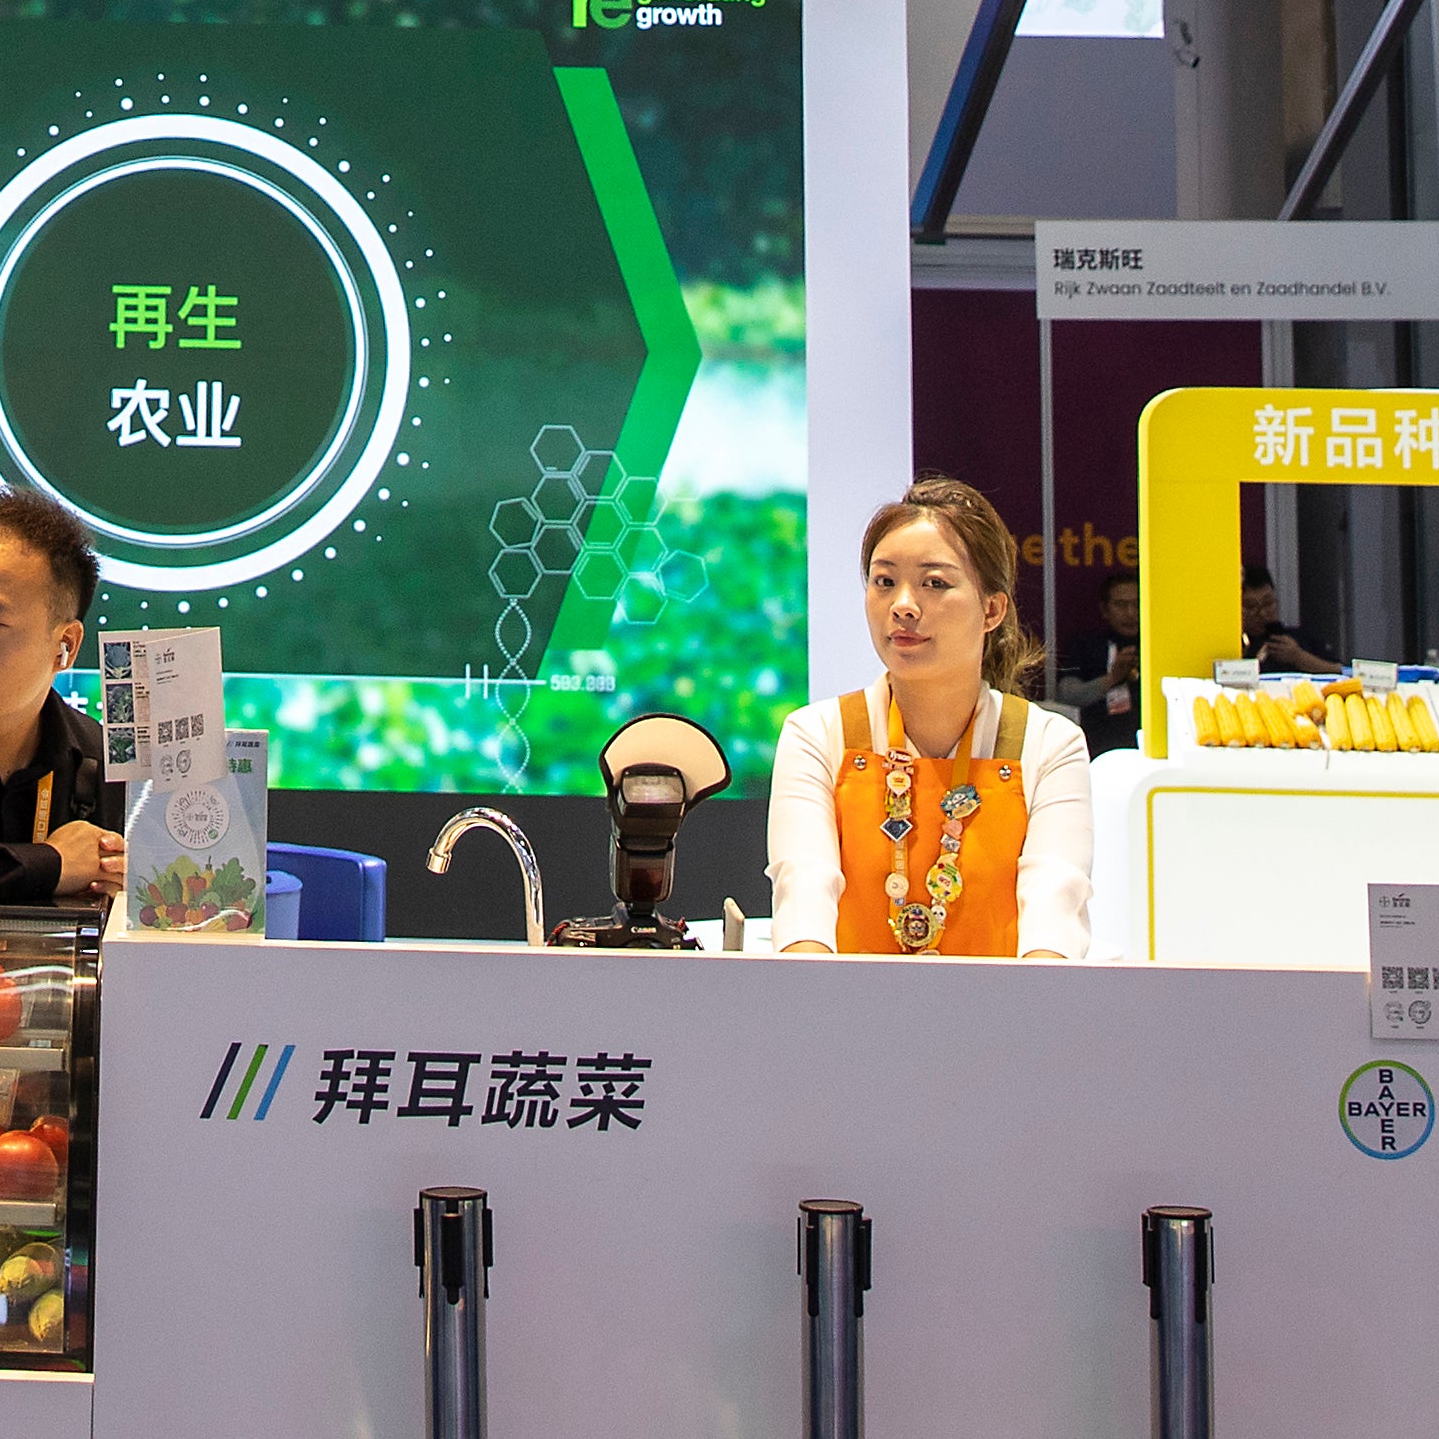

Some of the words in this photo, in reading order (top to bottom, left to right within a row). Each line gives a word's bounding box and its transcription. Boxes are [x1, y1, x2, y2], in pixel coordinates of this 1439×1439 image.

[635, 1, 723, 31] growth
[1053, 247, 1144, 271] 瑞克斯旺
[1053, 280, 1082, 299] Rijk
[1086, 280, 1141, 297] Zwaan
[1231, 283, 1252, 297] en
[1256, 279, 1358, 297] Zaadhandel
[1361, 280, 1392, 297] B.V.
[108, 283, 243, 351] 再生
[106, 379, 243, 450] 农业
[311, 1044, 653, 1134] 拜耳蔬菜
[1347, 1101, 1428, 1118] BAYER
[1377, 1068, 1398, 1152] BAYER
